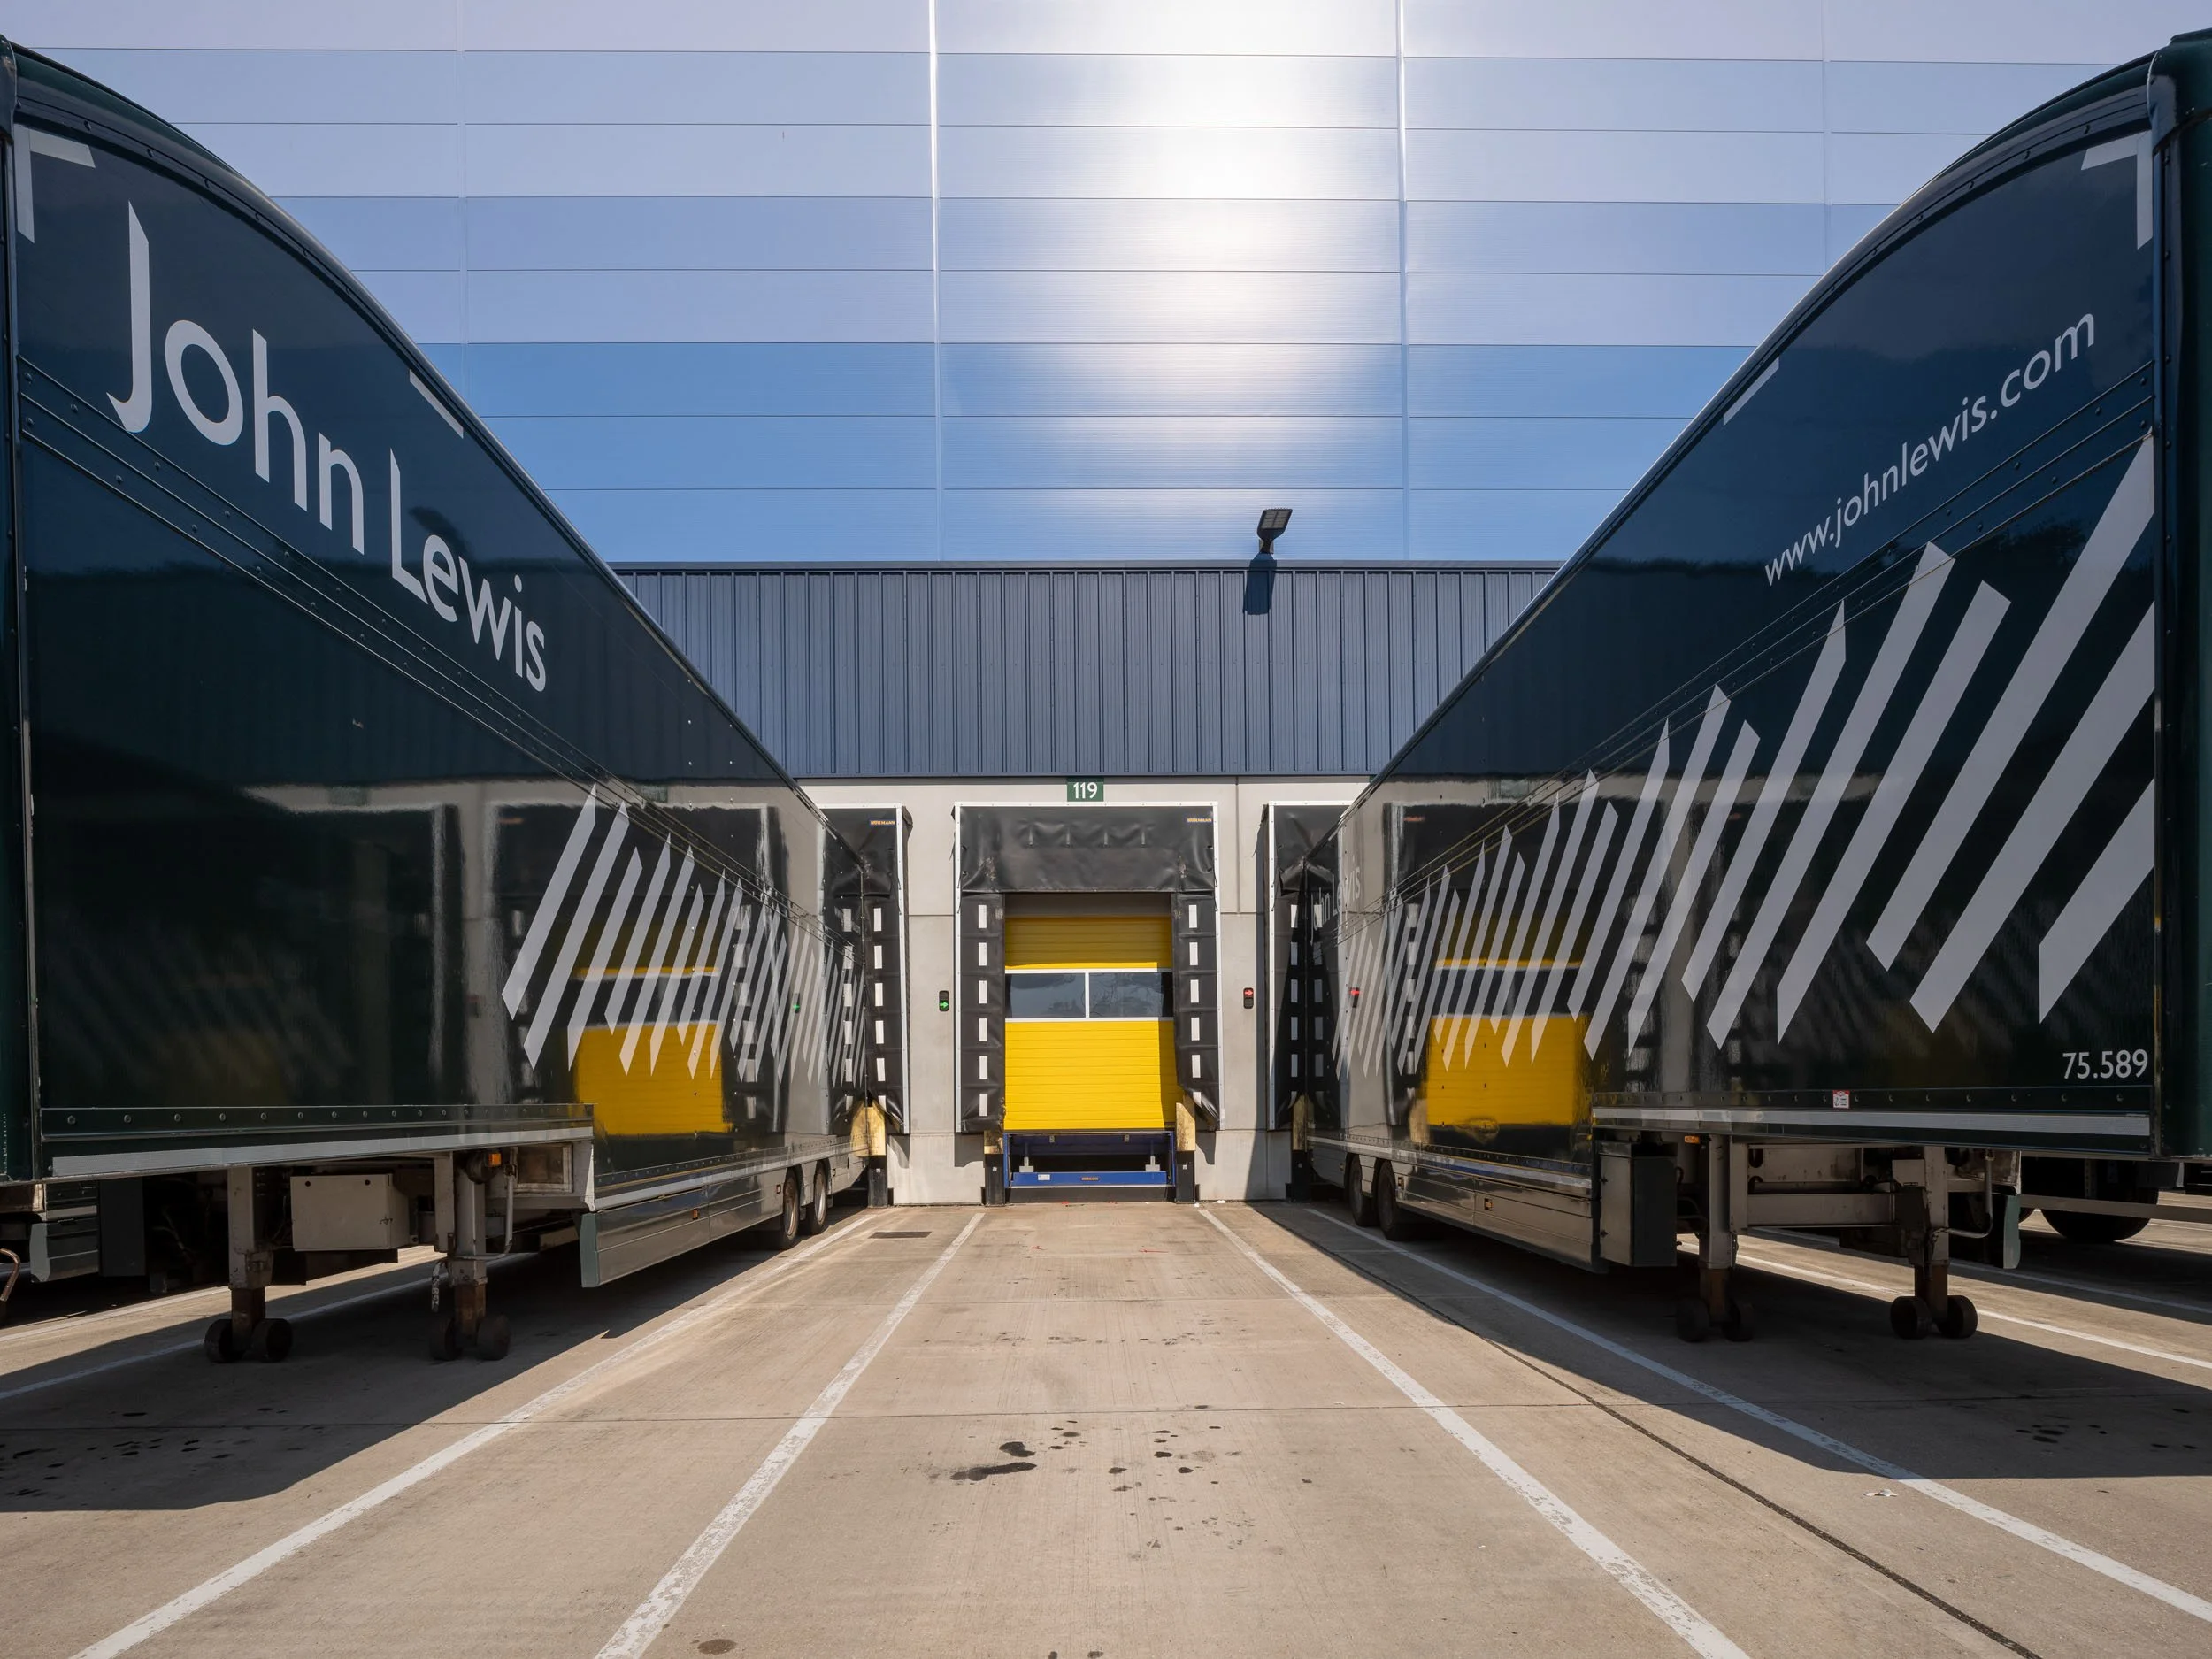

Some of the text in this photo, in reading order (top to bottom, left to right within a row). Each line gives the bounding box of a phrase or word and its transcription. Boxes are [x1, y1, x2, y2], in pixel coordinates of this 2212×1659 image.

[106, 200, 546, 692] John Lewis
[1764, 313, 2095, 587] www.johnlewis.com
[1073, 782, 1097, 799] 119
[2062, 1048, 2148, 1079] 75.589
